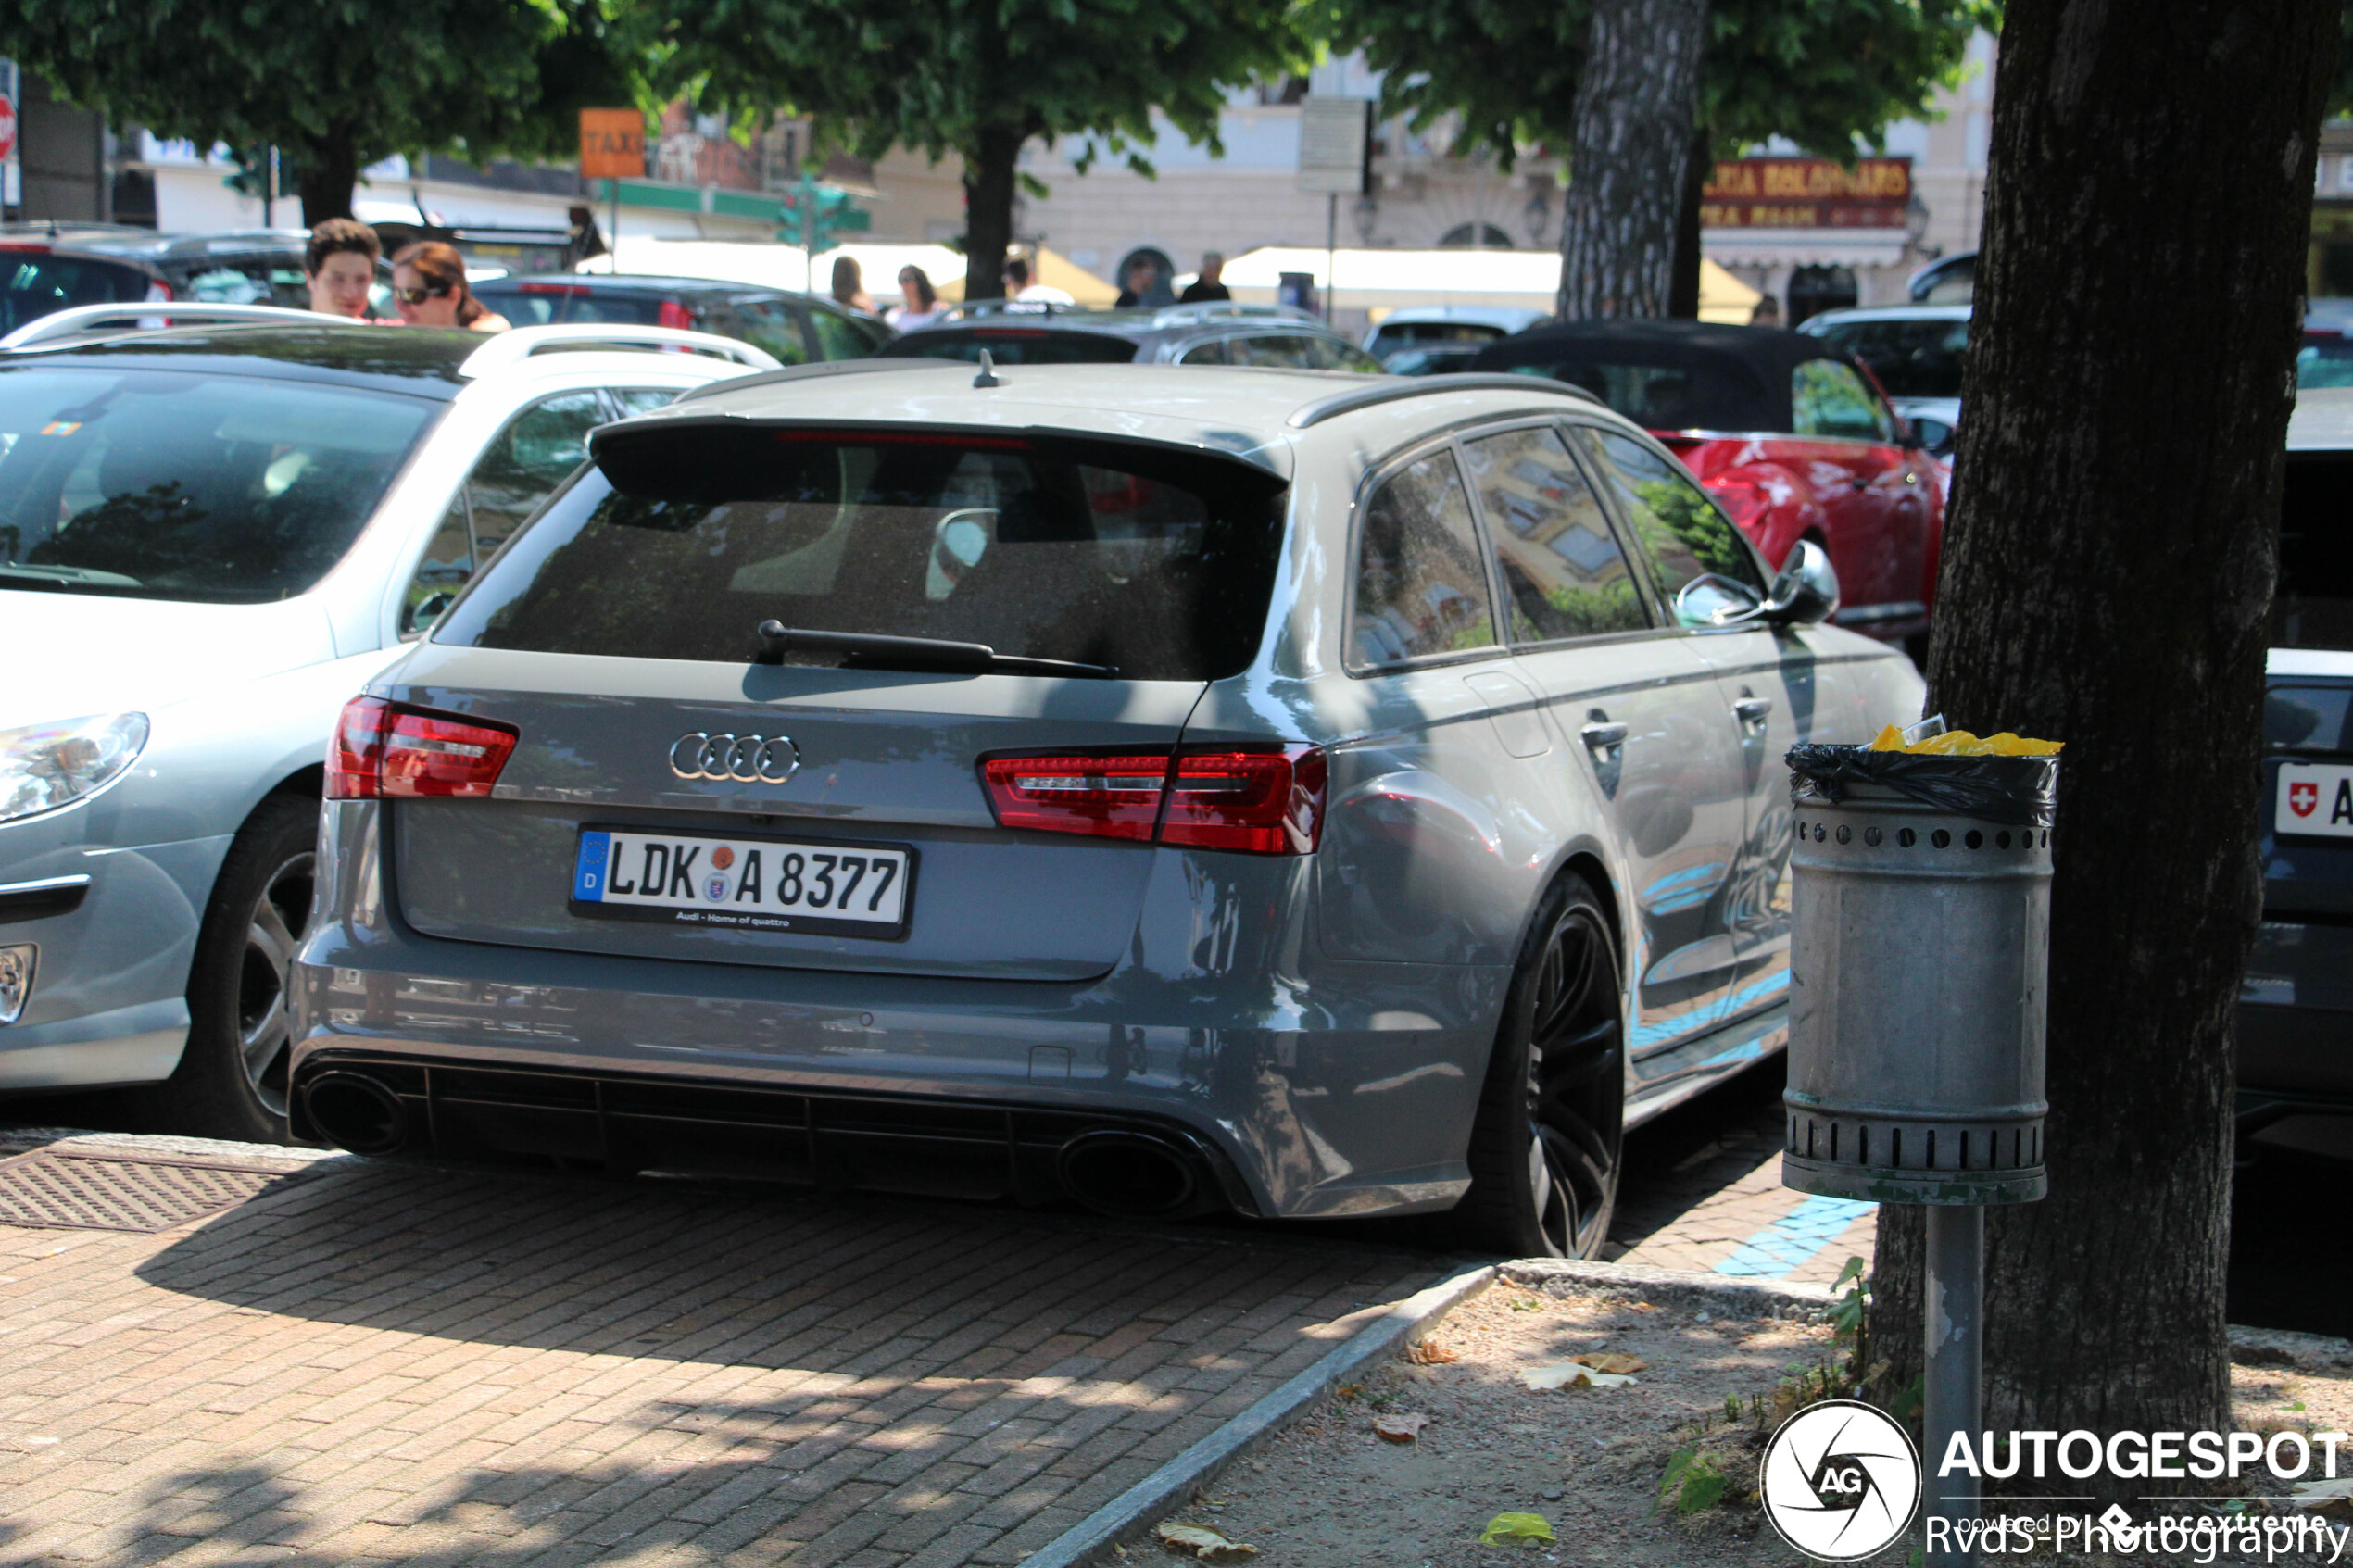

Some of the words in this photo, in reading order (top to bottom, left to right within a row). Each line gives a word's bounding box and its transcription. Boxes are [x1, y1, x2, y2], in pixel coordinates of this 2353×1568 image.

[585, 131, 643, 156] TAXI
[2331, 779, 2353, 824] A
[585, 873, 597, 888] D
[609, 842, 701, 898] LDK
[736, 850, 761, 903] A
[777, 853, 898, 911] 8377
[676, 912, 699, 921] Audi
[707, 914, 737, 923] Home
